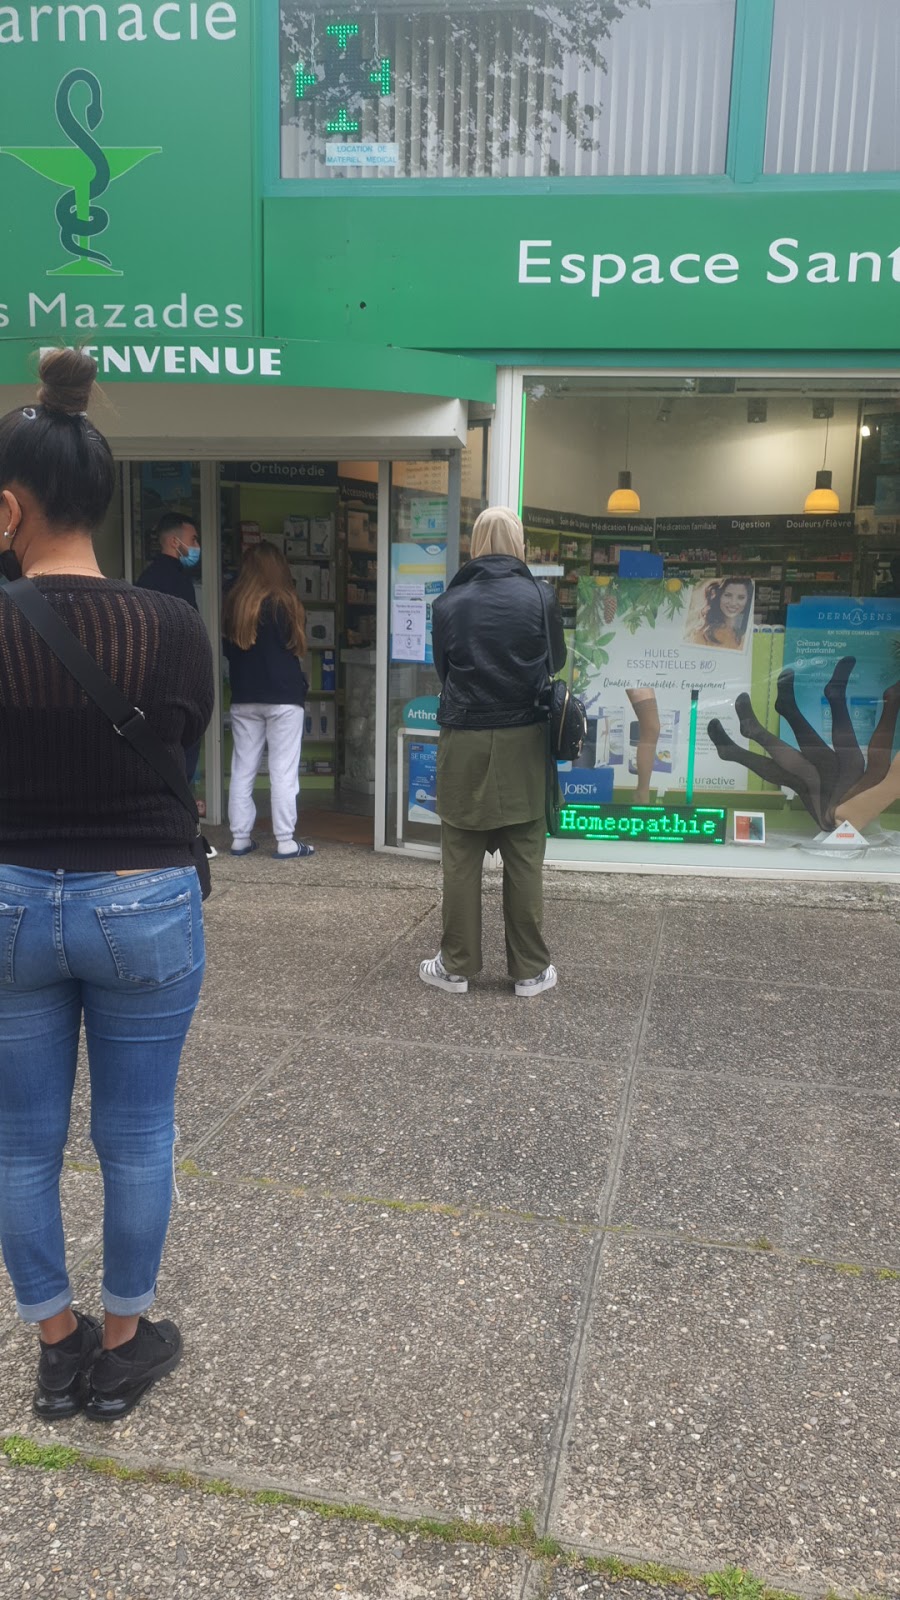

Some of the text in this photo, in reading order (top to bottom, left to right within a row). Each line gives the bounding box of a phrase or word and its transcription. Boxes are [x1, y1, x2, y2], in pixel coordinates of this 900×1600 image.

[0, 1, 237, 42] armacie
[518, 240, 739, 297] Espace
[28, 293, 244, 328] Mazades
[39, 345, 281, 376] NVENUE
[250, 462, 325, 477] Orthopédie
[591, 522, 653, 532] Médication familiale
[656, 522, 717, 531] Médication familiale
[731, 520, 771, 530] Digestion
[786, 519, 852, 528] Douleurs/Fièvre
[818, 611, 892, 621] DERMASENS
[406, 619, 413, 631] 2
[644, 649, 680, 658] HUILES
[627, 660, 713, 669] ESSENTIELLES BIO
[407, 708, 437, 720] Arthro
[678, 776, 736, 787] nuractive
[564, 782, 593, 795] JOBST
[560, 809, 716, 835] Homeopathie
